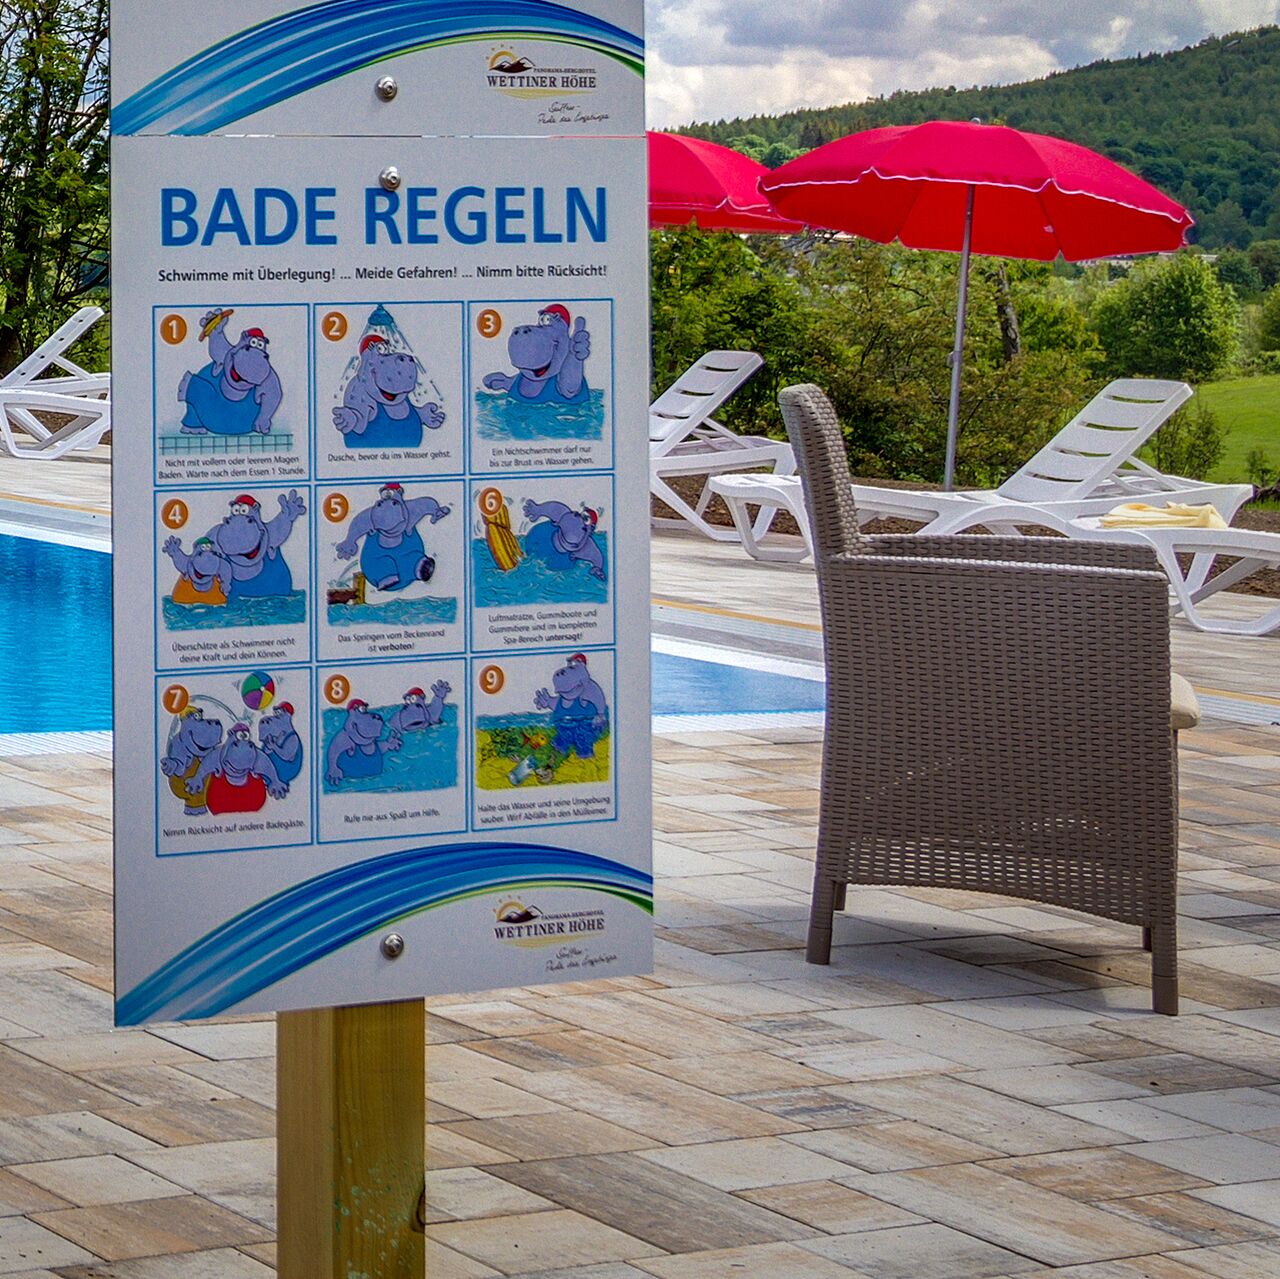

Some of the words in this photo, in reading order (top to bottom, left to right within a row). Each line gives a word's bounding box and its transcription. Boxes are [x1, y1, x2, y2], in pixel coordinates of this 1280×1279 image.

[487, 75, 557, 88] WETTINER
[561, 74, 597, 88] HÖHE
[160, 187, 337, 246] BADE
[365, 185, 607, 245] REGELN
[158, 269, 228, 282] Schwimme
[233, 268, 254, 281] mit
[258, 266, 335, 283] Überlegung!
[355, 267, 393, 279] Meide
[397, 266, 457, 279] Gefahren!
[476, 266, 512, 278] Nimm
[516, 265, 544, 277] bitte
[547, 264, 607, 277] Rücksicht!
[168, 320, 179, 338] 1
[328, 317, 340, 335] 2
[483, 314, 495, 332] 3
[165, 459, 185, 467] Nicht
[187, 458, 199, 466] mit
[201, 457, 226, 466] vollem
[228, 457, 245, 465] oder
[247, 456, 272, 465] leerem
[274, 456, 299, 465] Magen
[185, 469, 209, 478] Warte
[210, 469, 229, 477] nach
[230, 468, 247, 477] dem
[248, 468, 269, 476] Essen
[329, 499, 342, 517] 5
[485, 492, 498, 511] 6
[168, 505, 182, 523] 4
[485, 671, 499, 689] 9
[330, 680, 344, 699] 8
[169, 689, 182, 709] 7
[494, 923, 565, 939] WETTINER
[569, 918, 605, 933] HÖHE
